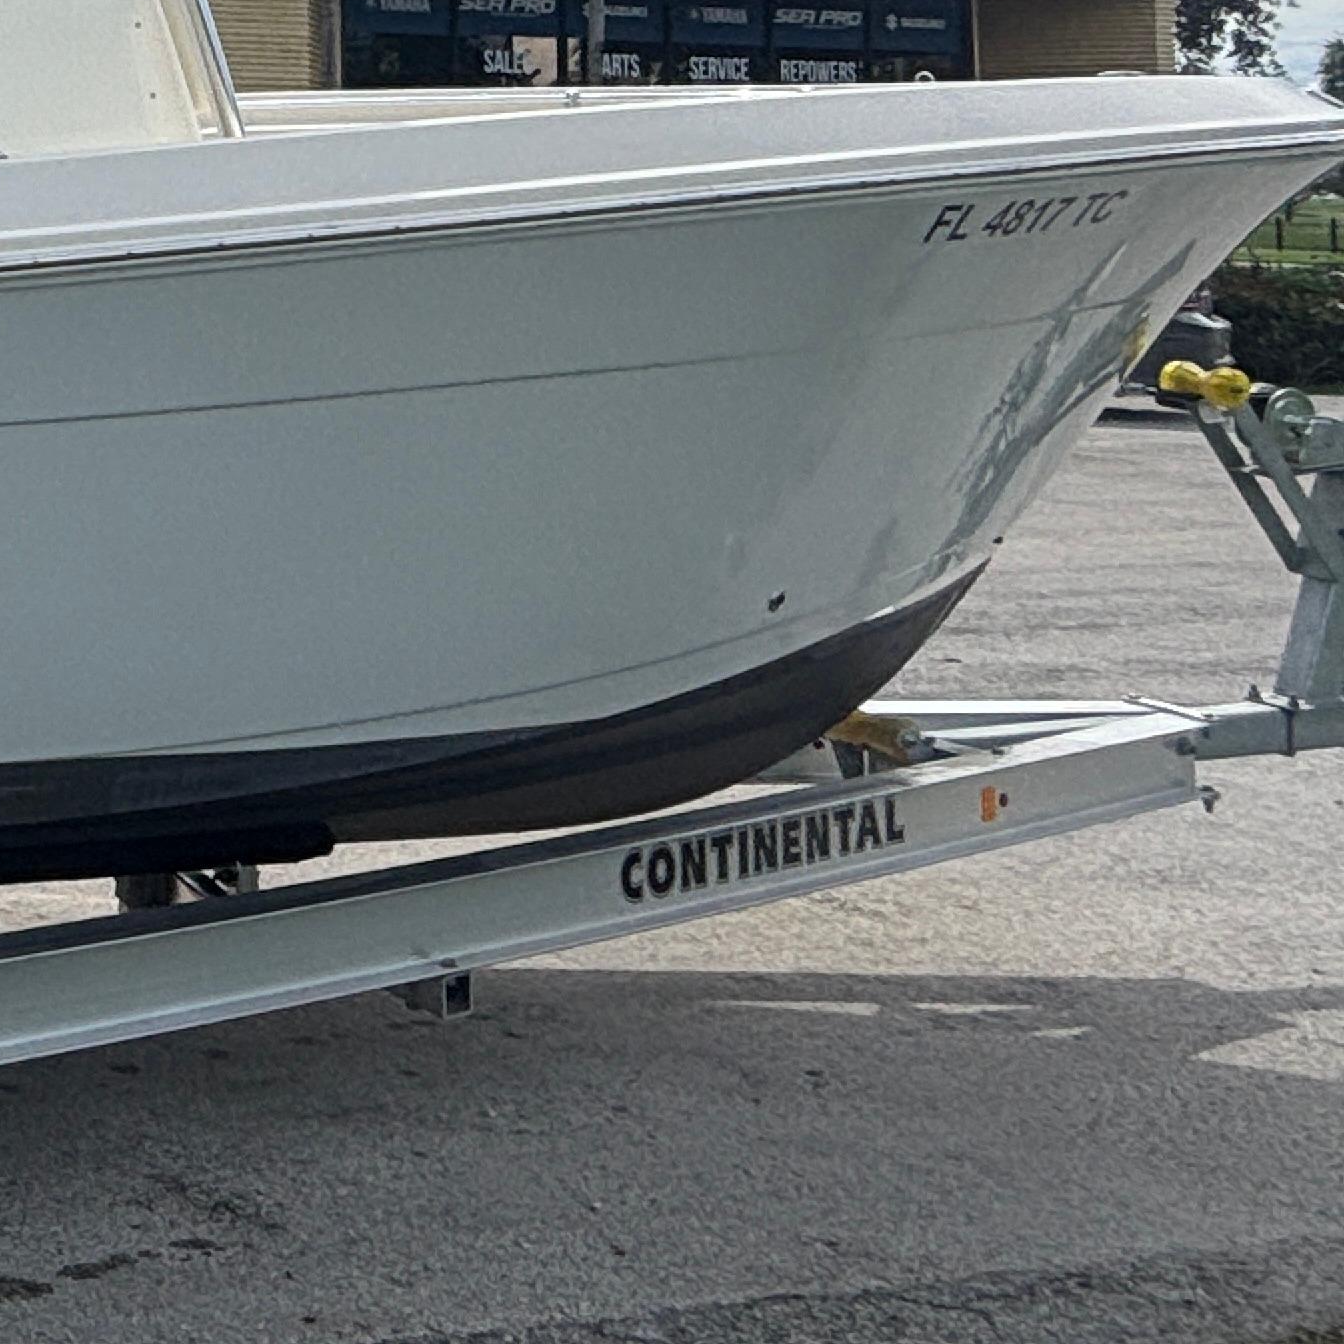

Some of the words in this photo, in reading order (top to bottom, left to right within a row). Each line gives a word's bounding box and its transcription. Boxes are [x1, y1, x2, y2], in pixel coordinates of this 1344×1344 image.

[772, 8, 816, 24] SEA
[818, 10, 863, 27] PRO
[600, 52, 641, 79] ARTS
[688, 55, 750, 81] SERVICE
[779, 58, 858, 82] REPOWERS
[922, 203, 976, 244] FL
[980, 197, 1079, 238] 4817
[1072, 189, 1129, 228] TC
[620, 795, 907, 902] CONTINENTAL
